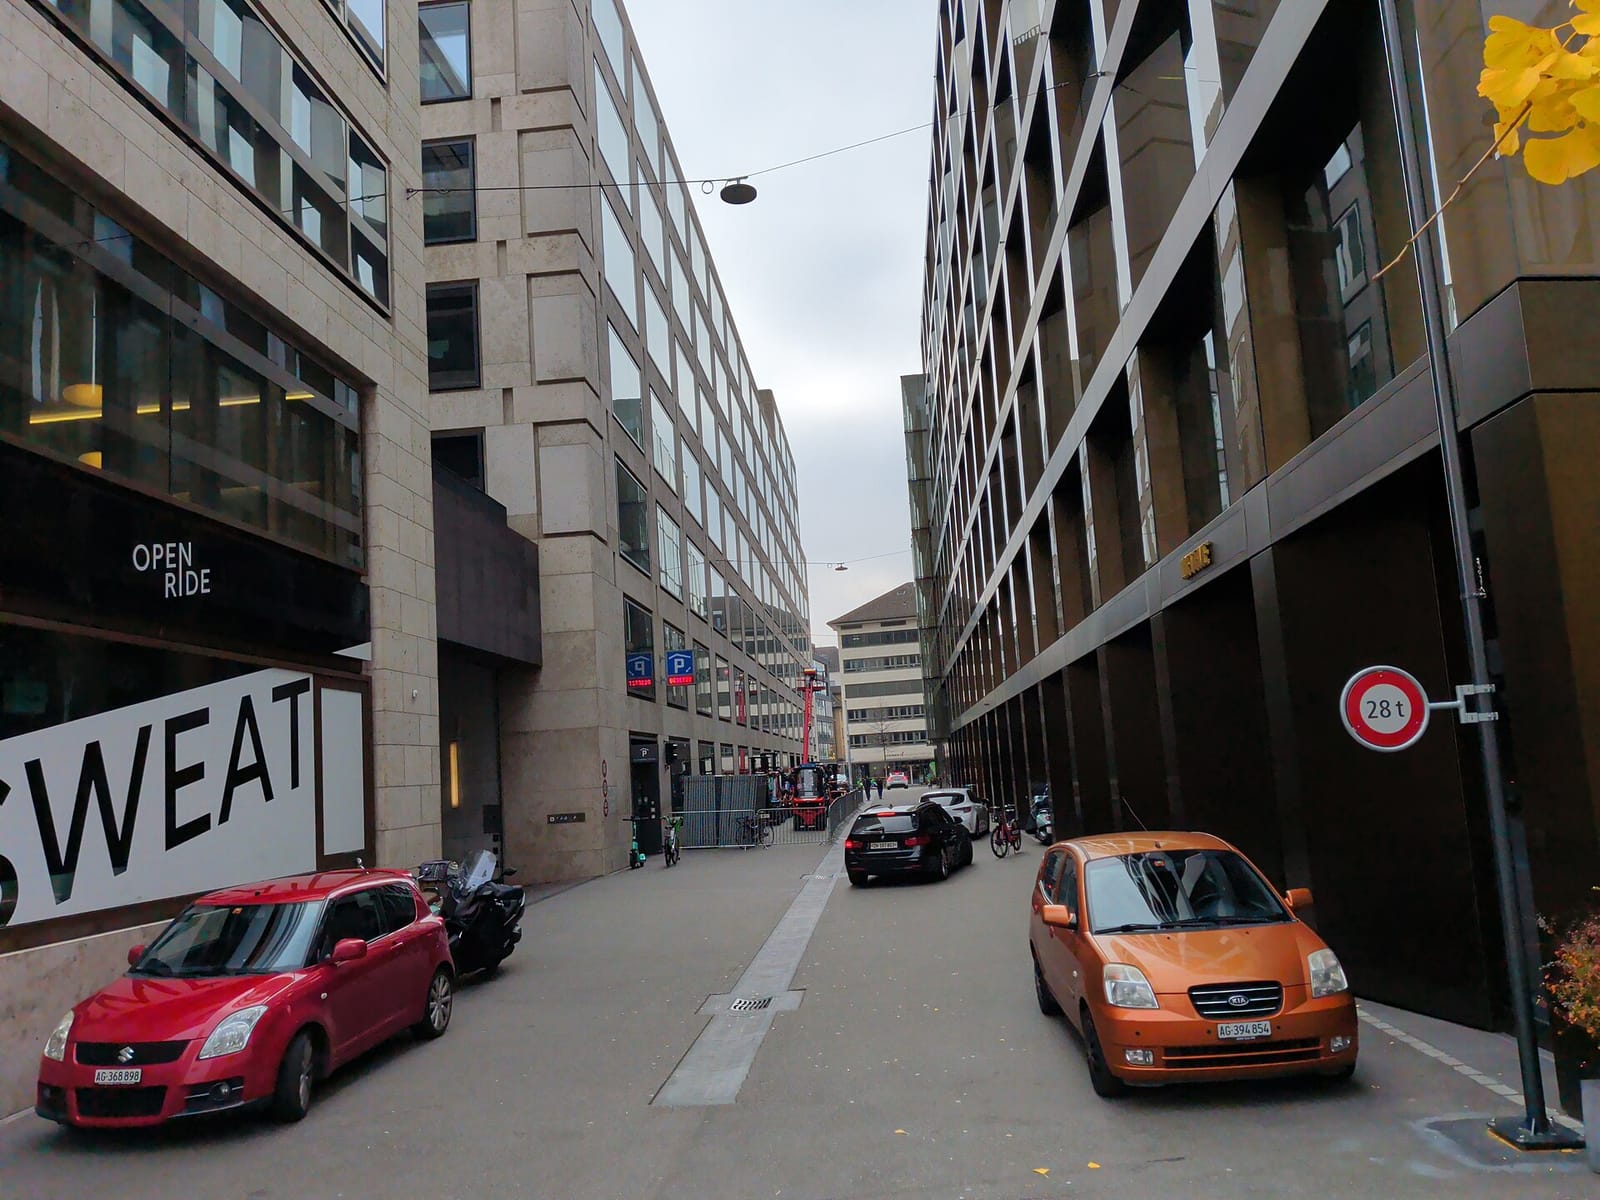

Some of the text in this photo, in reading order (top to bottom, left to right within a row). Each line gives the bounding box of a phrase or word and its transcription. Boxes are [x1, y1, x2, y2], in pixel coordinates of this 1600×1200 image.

[132, 542, 192, 571] OPEN
[165, 569, 211, 598] RIDE
[674, 658, 685, 673] P
[1231, 997, 1246, 1005] KIA
